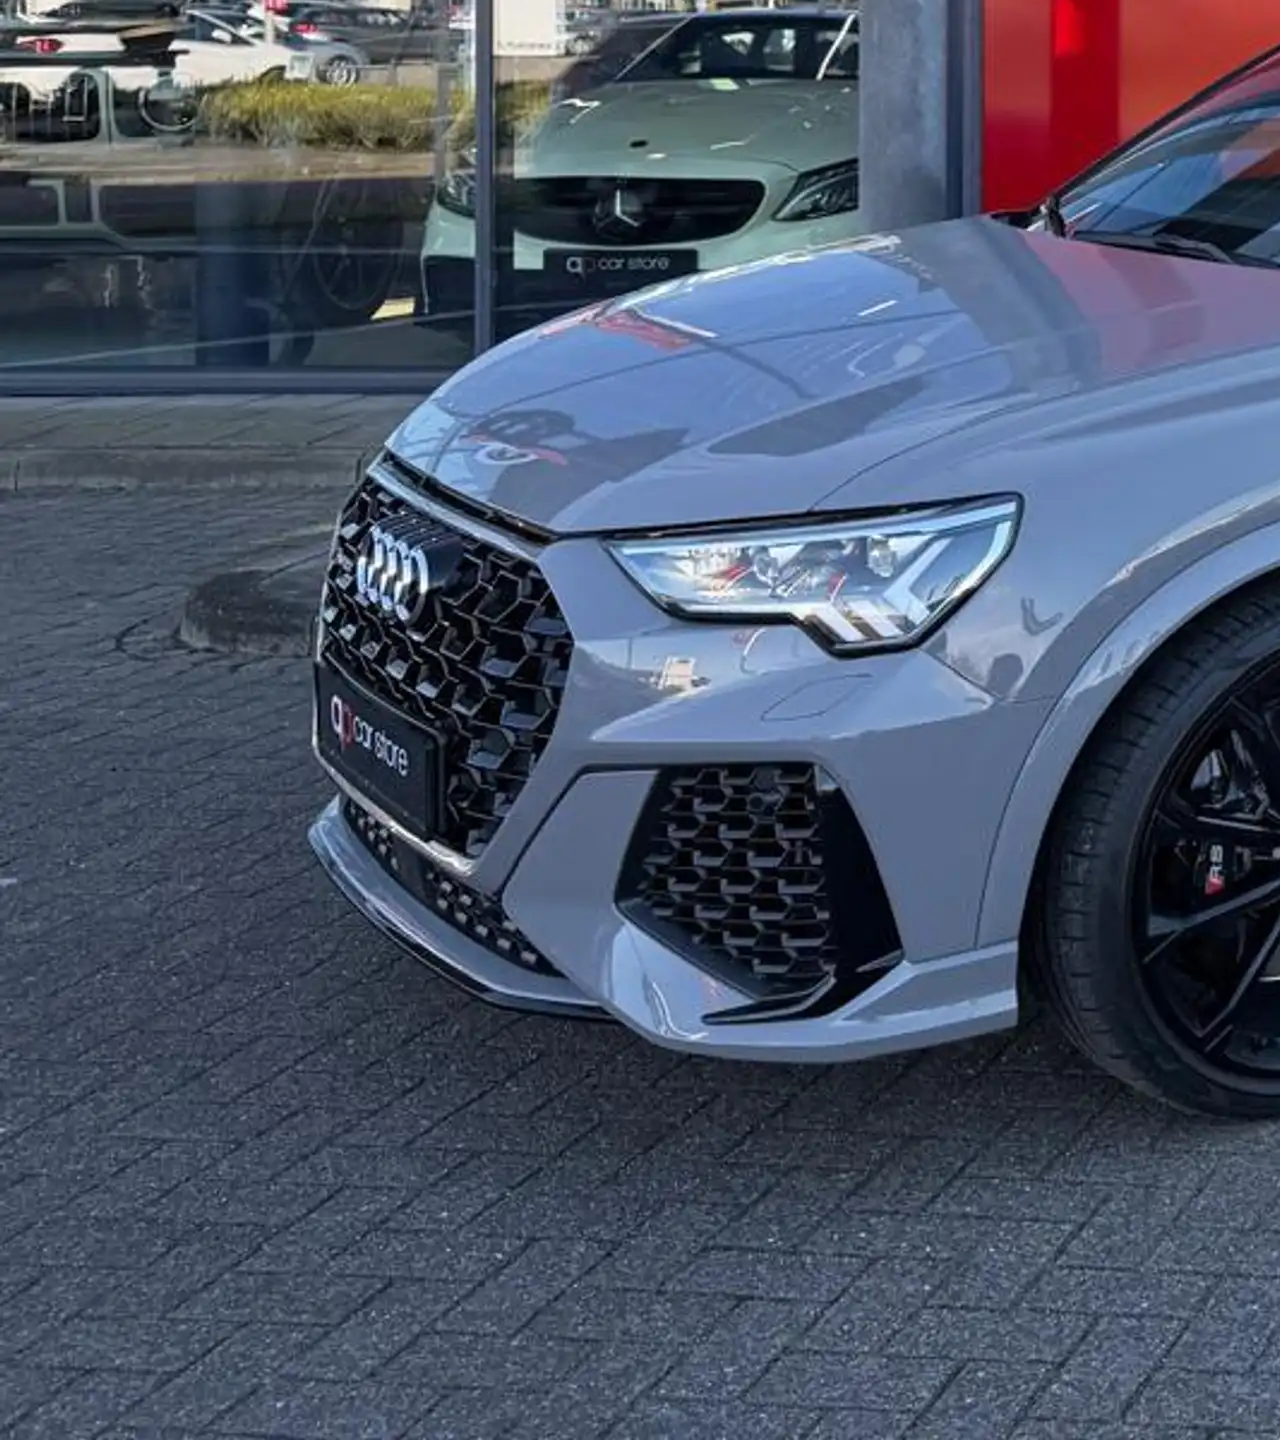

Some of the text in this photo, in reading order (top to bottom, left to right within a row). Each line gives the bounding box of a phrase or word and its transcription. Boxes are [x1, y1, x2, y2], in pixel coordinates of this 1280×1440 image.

[598, 258, 625, 270] car
[627, 256, 671, 271] store
[353, 715, 374, 750] car
[374, 730, 408, 777] store
